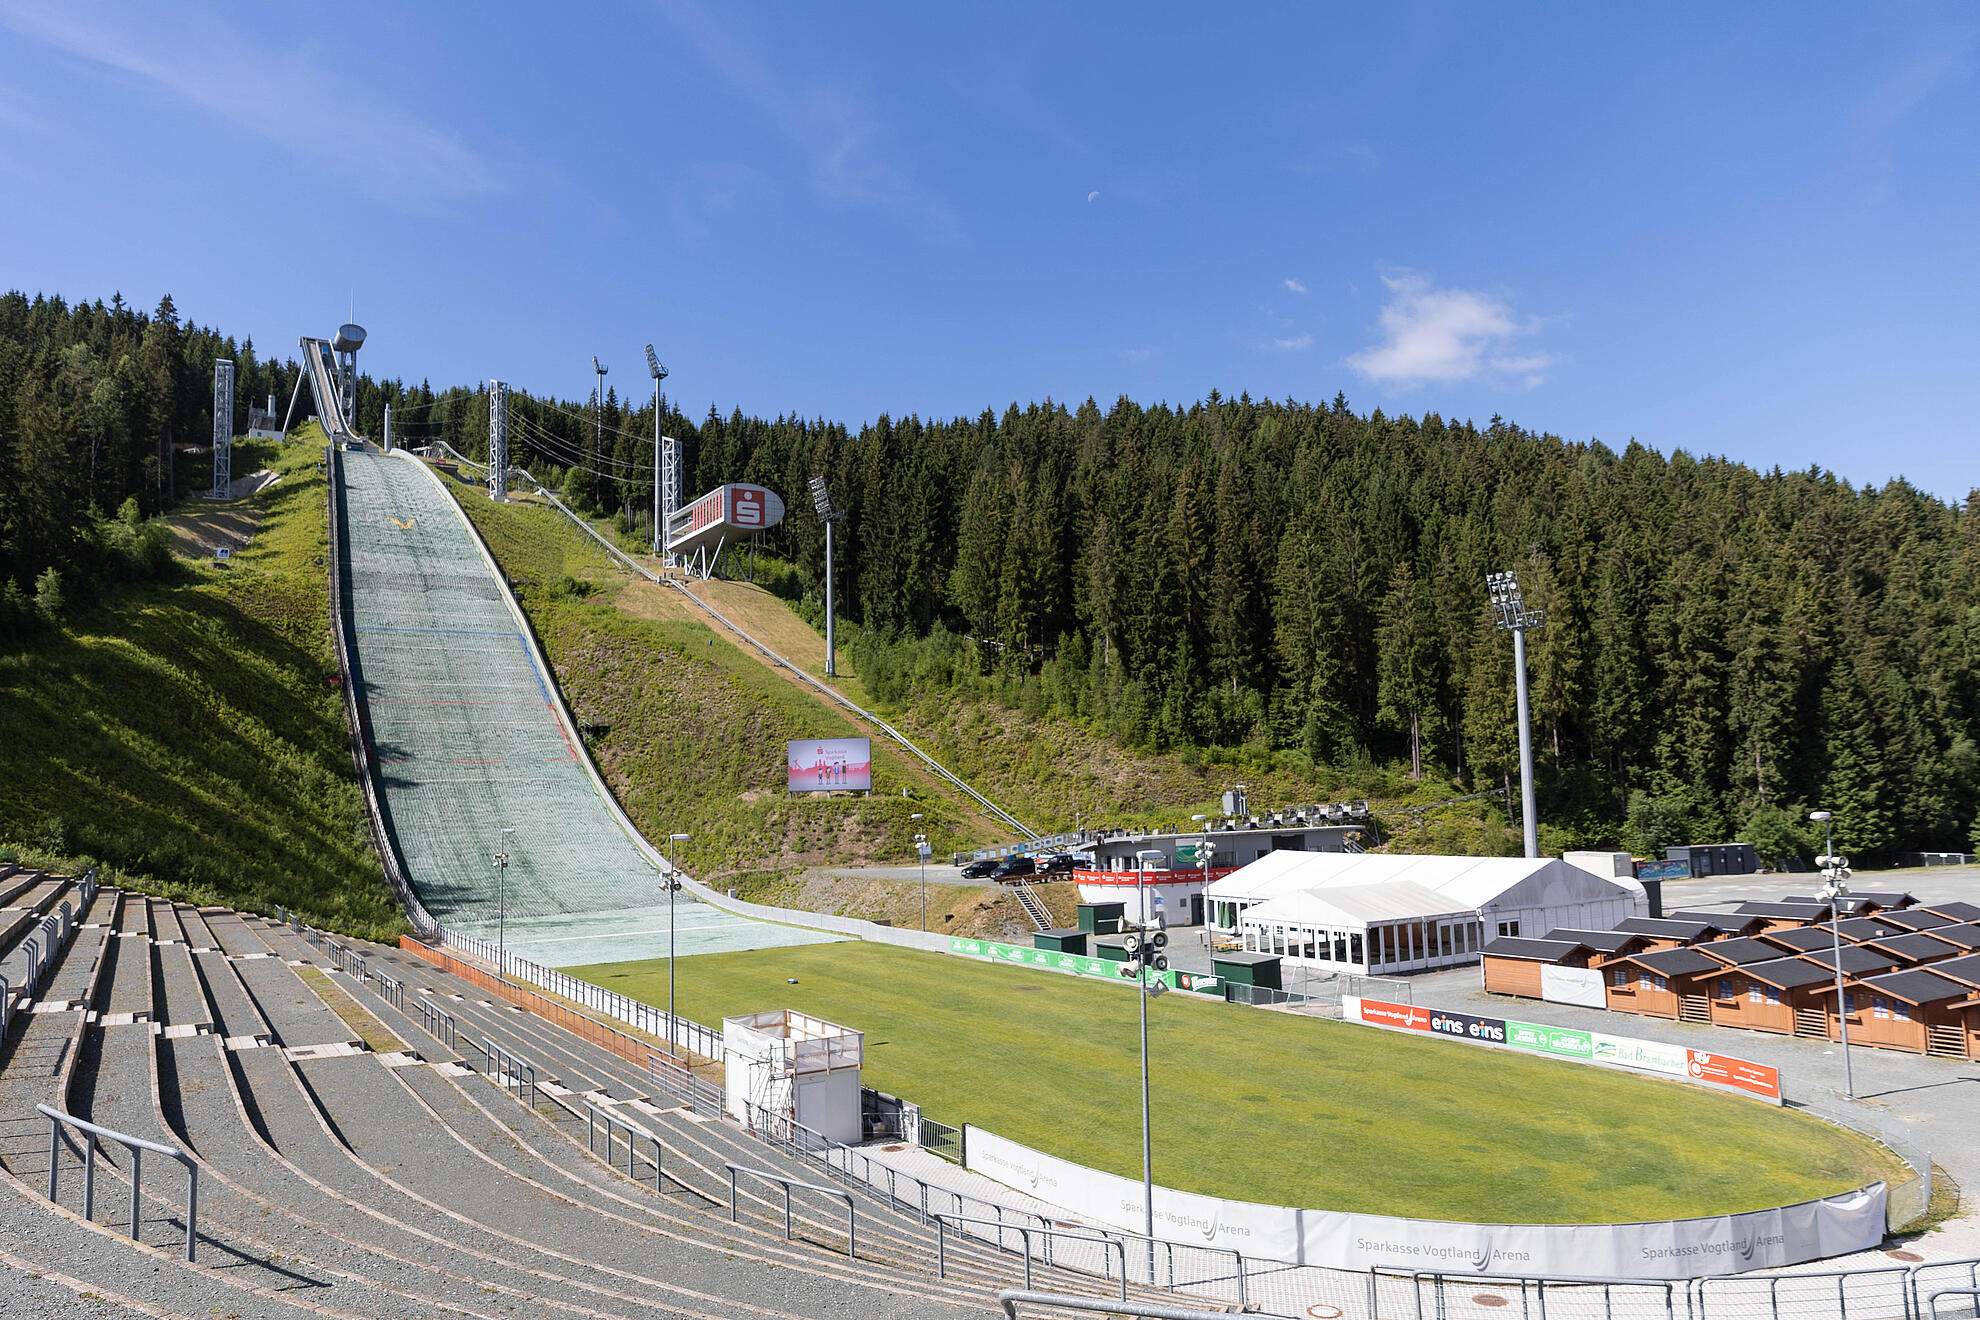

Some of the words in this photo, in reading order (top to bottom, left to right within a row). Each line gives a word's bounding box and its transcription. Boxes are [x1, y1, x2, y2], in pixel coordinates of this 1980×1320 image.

[1431, 1014, 1464, 1034] eins
[1469, 1020, 1504, 1041] eins
[1617, 1047, 1634, 1061] Bad
[1635, 1046, 1685, 1069] Brambacher
[981, 1150, 1009, 1169] Sparkasse
[1009, 1160, 1035, 1179] Vogtland
[1039, 1173, 1057, 1187] Arena
[1165, 1211, 1209, 1230] Vogtland
[1218, 1223, 1251, 1237] Arena
[1357, 1238, 1420, 1256] Sparkasse
[1423, 1244, 1481, 1260] Vogtland
[1492, 1249, 1530, 1261] Arena
[1641, 1241, 1699, 1260] Sparkasse
[1700, 1239, 1748, 1256] Vogtland
[1755, 1233, 1785, 1248] Arena
